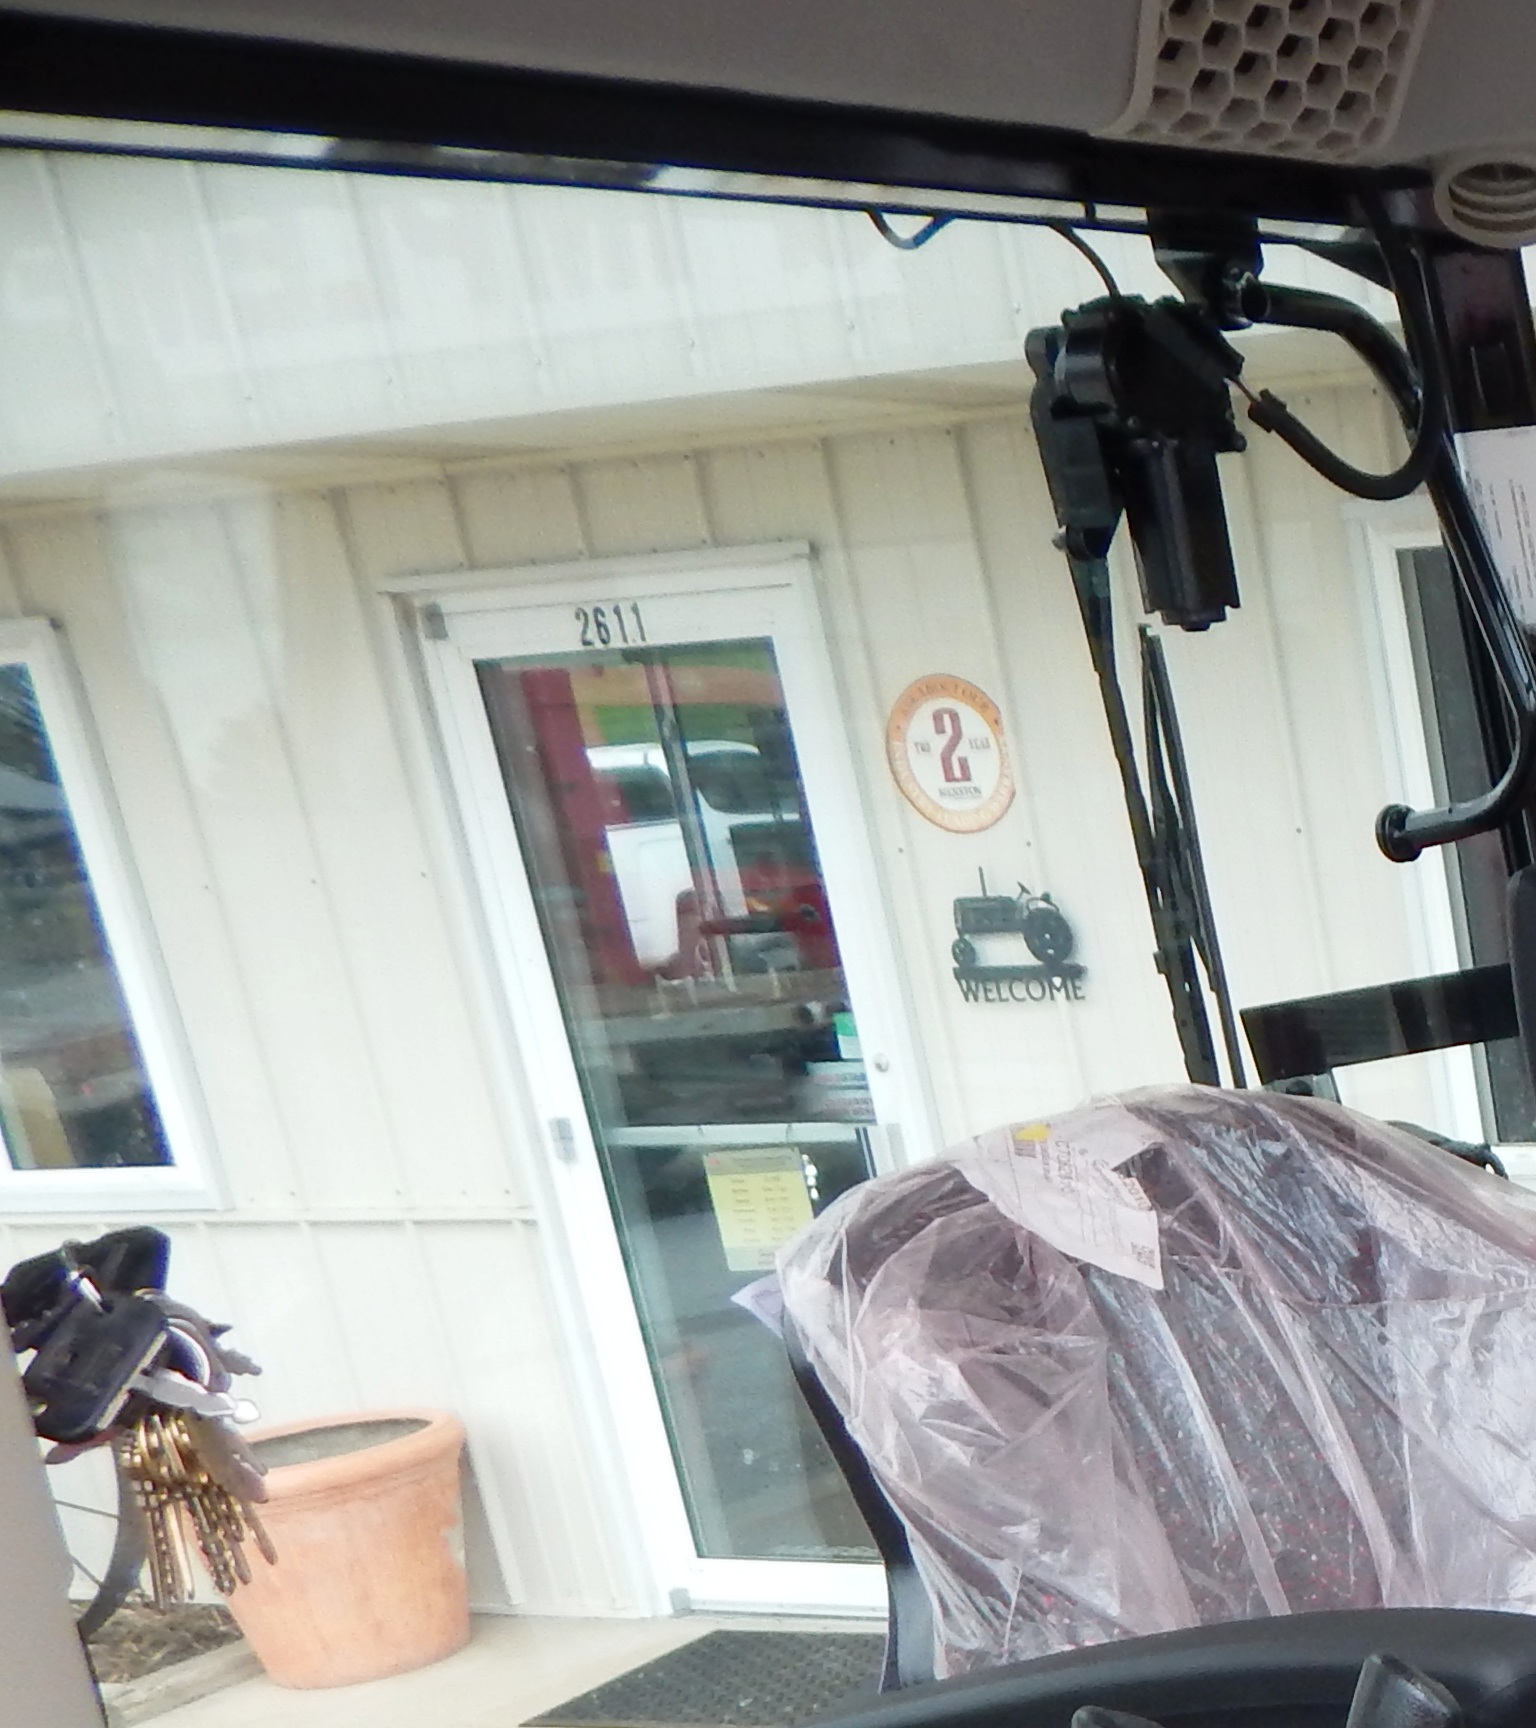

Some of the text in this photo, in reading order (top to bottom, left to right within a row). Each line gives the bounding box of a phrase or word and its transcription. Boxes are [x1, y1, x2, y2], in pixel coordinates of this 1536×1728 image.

[575, 603, 647, 646] 2611
[932, 708, 971, 782] 2
[954, 976, 1086, 1002] WELCOME
